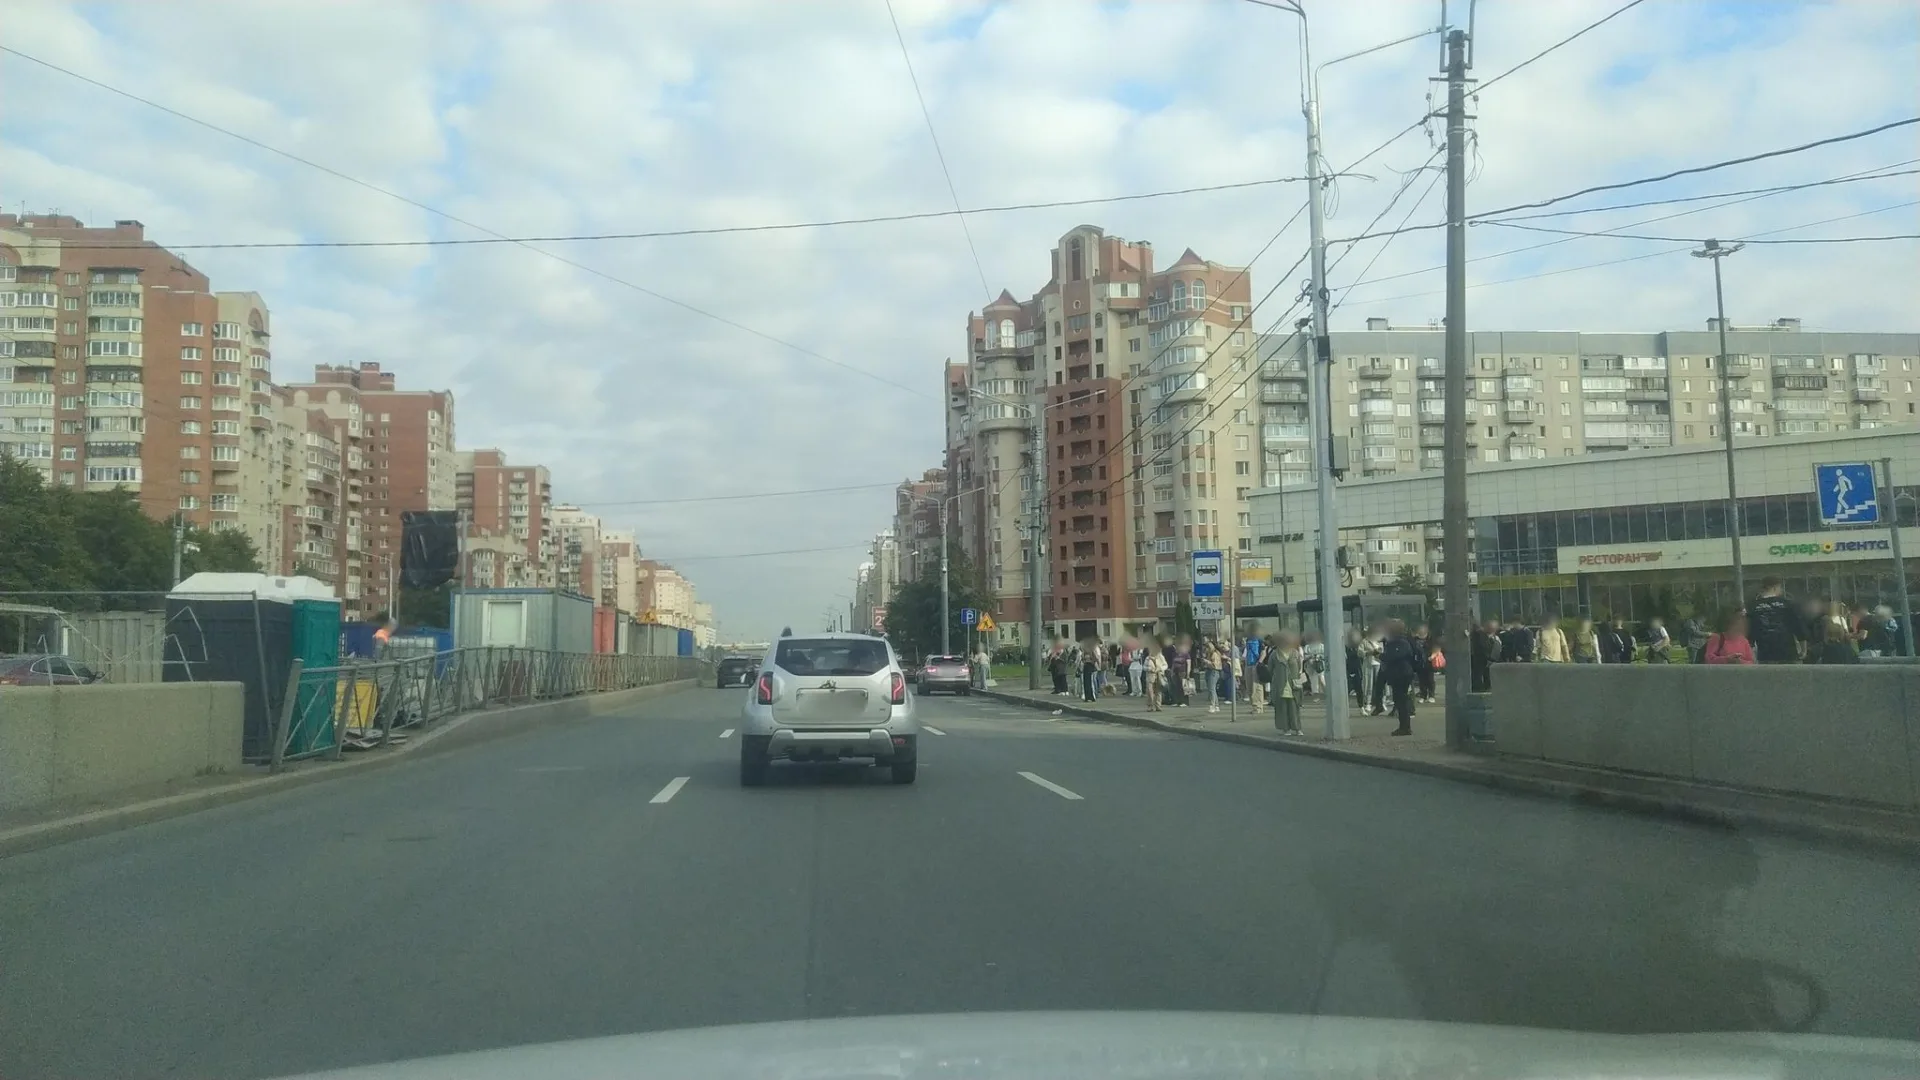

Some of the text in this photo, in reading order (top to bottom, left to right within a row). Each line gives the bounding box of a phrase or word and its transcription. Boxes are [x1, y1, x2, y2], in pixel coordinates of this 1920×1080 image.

[1769, 540, 1890, 557] супер лента
[1578, 552, 1640, 565] РЕСТОРАН
